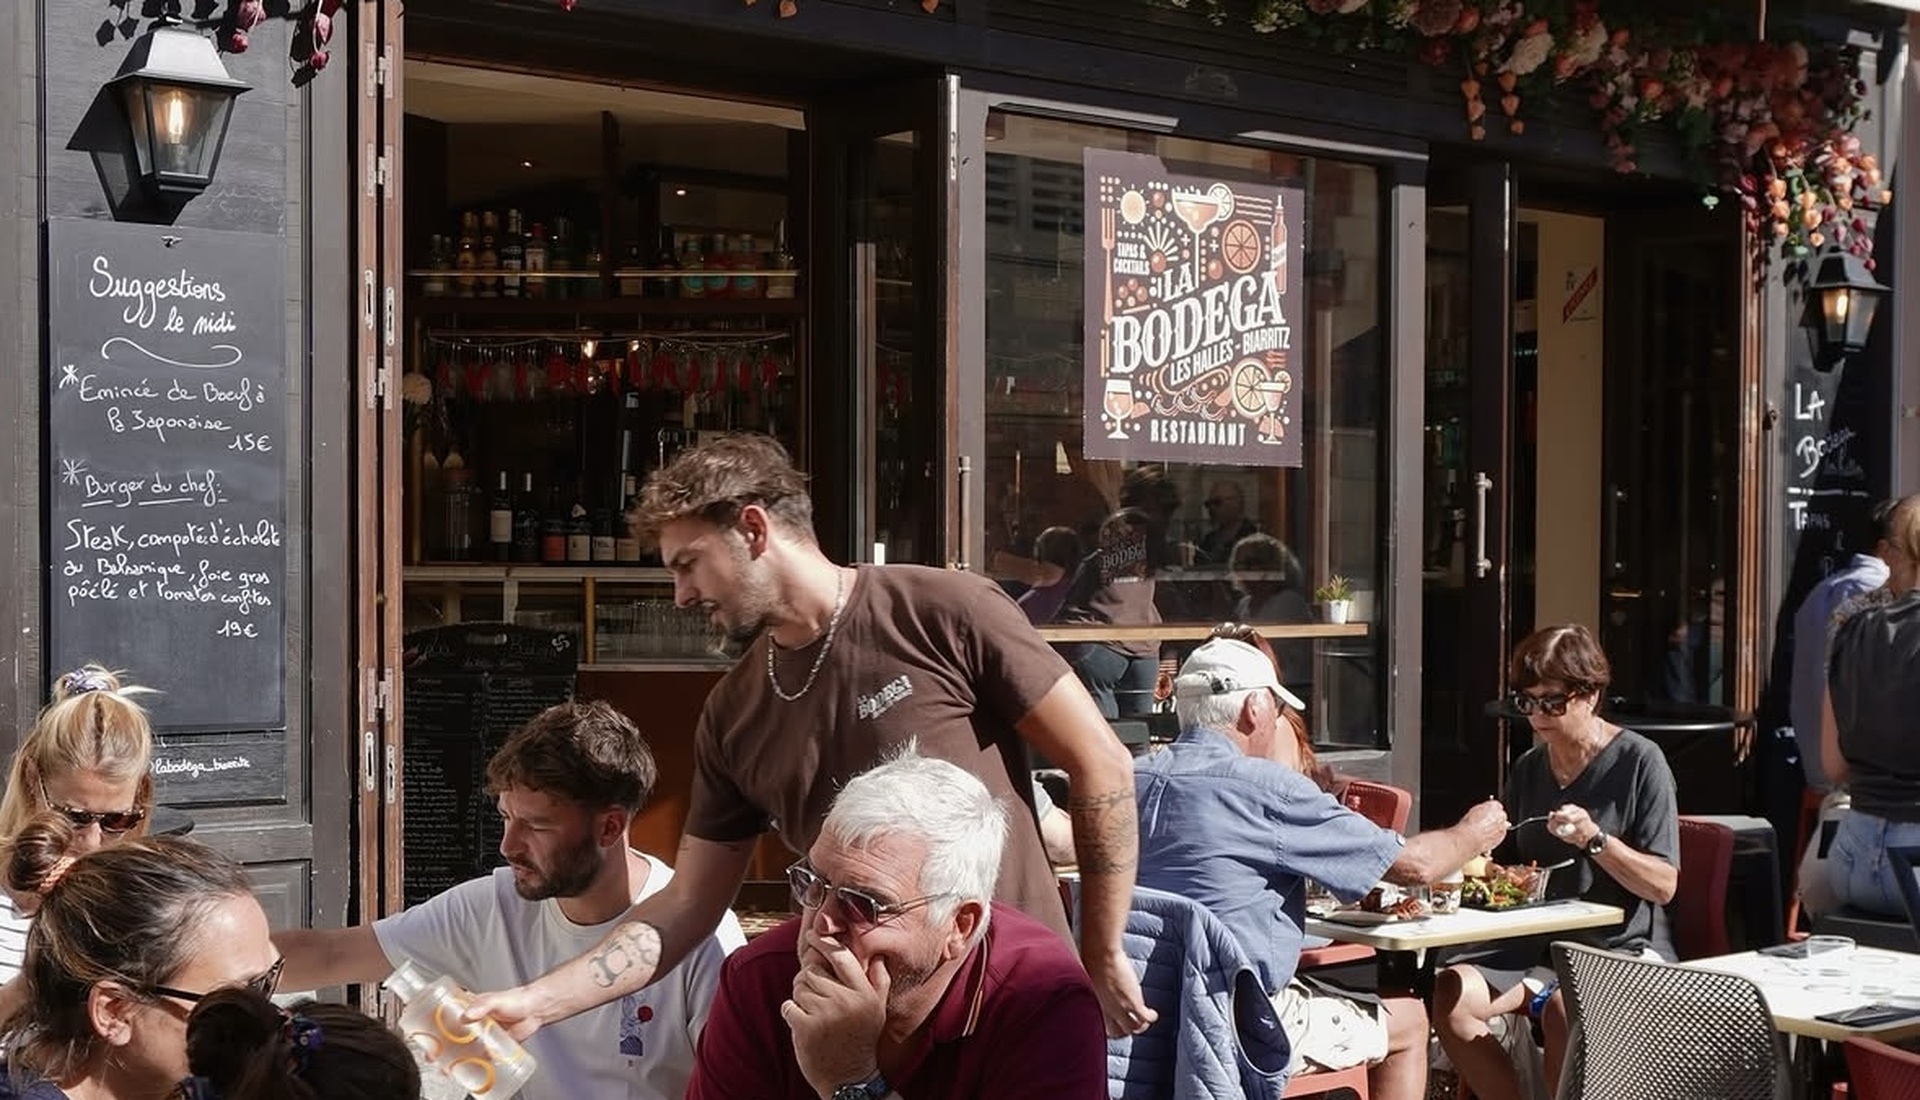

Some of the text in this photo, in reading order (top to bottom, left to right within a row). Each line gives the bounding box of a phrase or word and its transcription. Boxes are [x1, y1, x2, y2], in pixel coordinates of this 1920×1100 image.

[1113, 258, 1150, 275] COCKTAILS
[1139, 244, 1147, 259] &
[89, 256, 226, 328] Suggestions
[1163, 263, 1195, 302] LA
[163, 305, 236, 336] le midi
[1110, 270, 1286, 374] BODEGA
[1170, 356, 1191, 386] LES
[1192, 338, 1234, 376] HALLES
[1242, 326, 1291, 356] BIARRITZ
[167, 379, 197, 401] de
[1795, 383, 1825, 420] LA
[131, 409, 232, 443] Japonaise
[1150, 419, 1247, 446] RESTAURANT
[228, 433, 272, 452] 15€
[84, 474, 146, 508] Burger
[151, 472, 172, 494] du
[63, 560, 84, 577] au
[198, 559, 233, 588] foie
[237, 572, 270, 590] gras
[128, 580, 149, 600] et
[156, 580, 217, 602] tomates
[220, 588, 272, 615] confites
[216, 620, 259, 638] 19€
